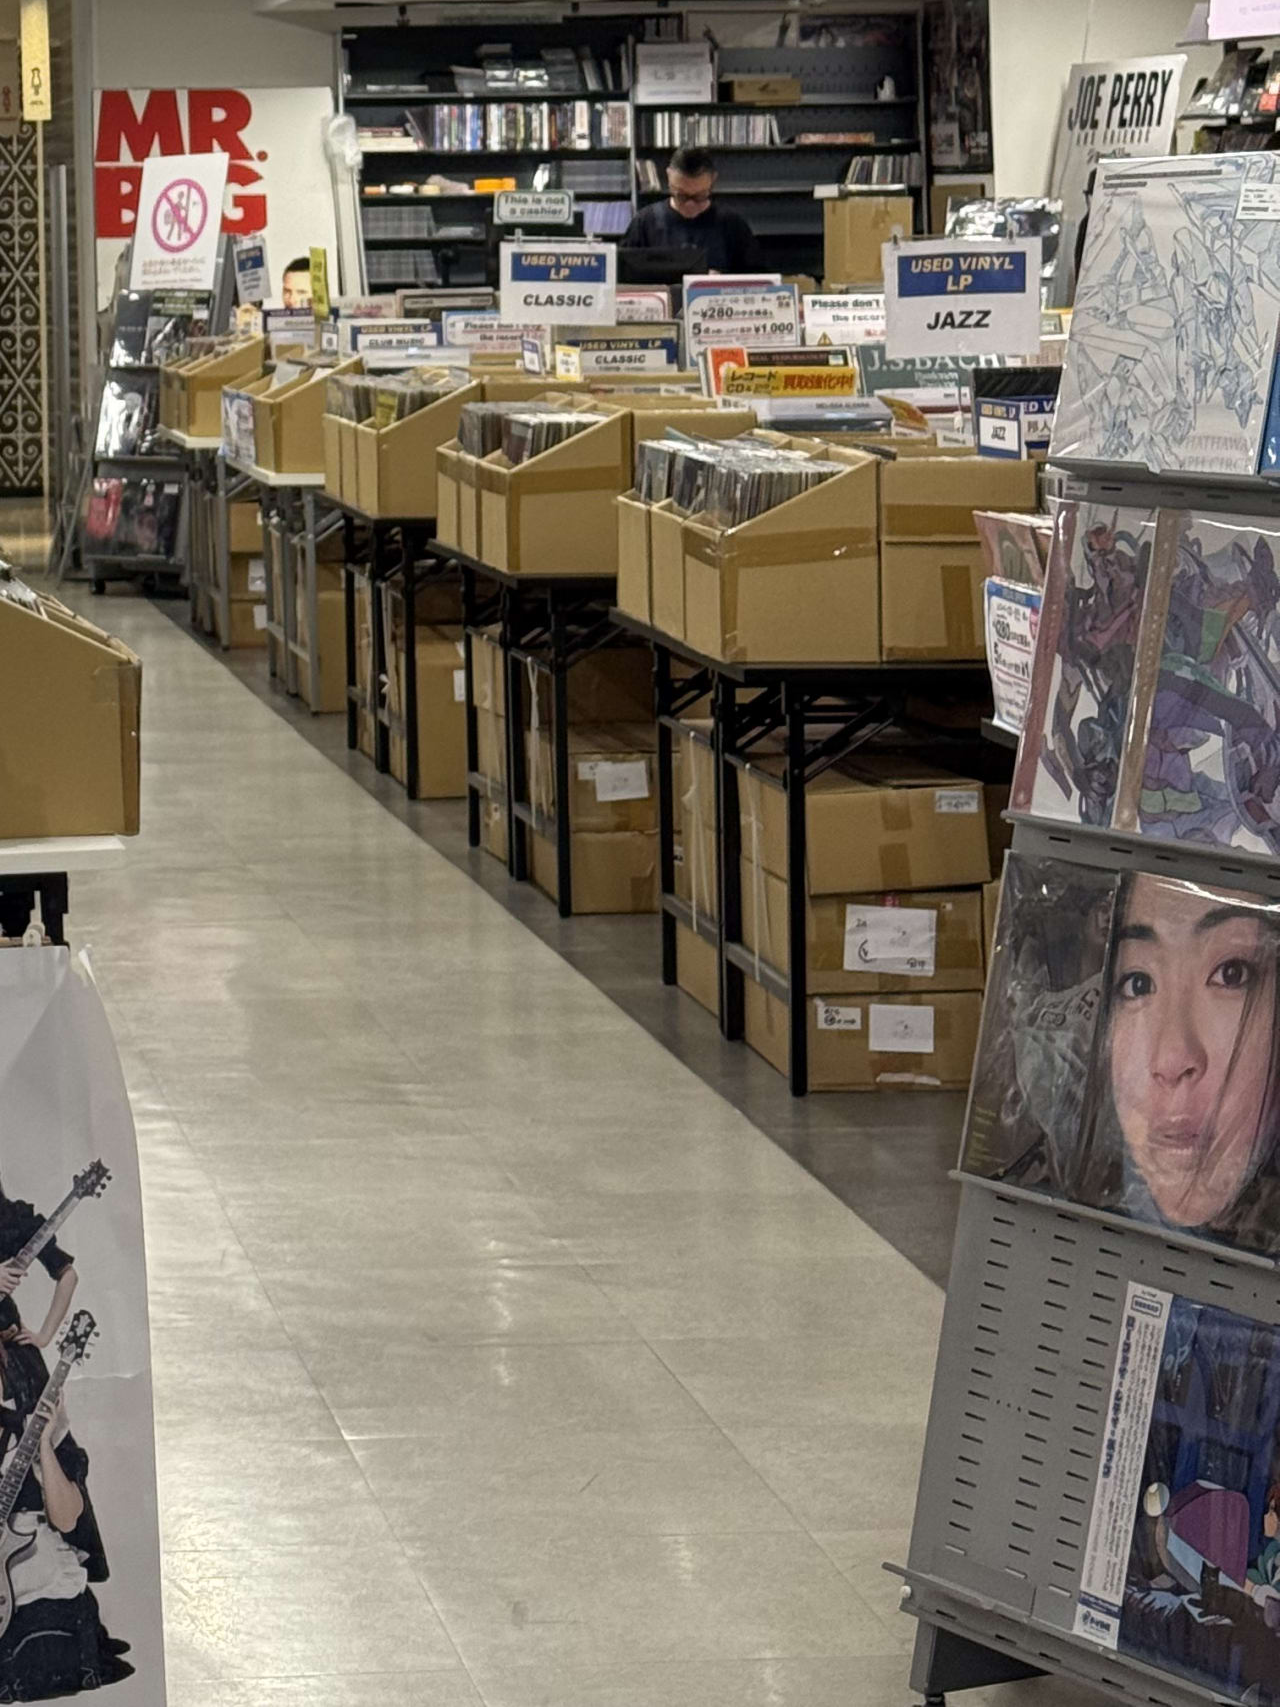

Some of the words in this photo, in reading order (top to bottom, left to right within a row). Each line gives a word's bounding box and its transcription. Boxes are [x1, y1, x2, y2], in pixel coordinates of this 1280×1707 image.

[1067, 73, 1107, 132] JOE
[1106, 68, 1174, 130] PERRY
[95, 89, 269, 163] MR.
[95, 163, 268, 239] BG
[521, 255, 556, 266] USED
[559, 255, 599, 266] VINYL
[911, 257, 954, 274] USED
[958, 256, 1015, 271] VINYL
[549, 268, 570, 280] LP
[946, 275, 974, 292] LP
[523, 293, 595, 308] CLASSIC
[810, 298, 849, 309] Please
[926, 309, 992, 331] JAZZ
[594, 354, 647, 365] CLASSIC
